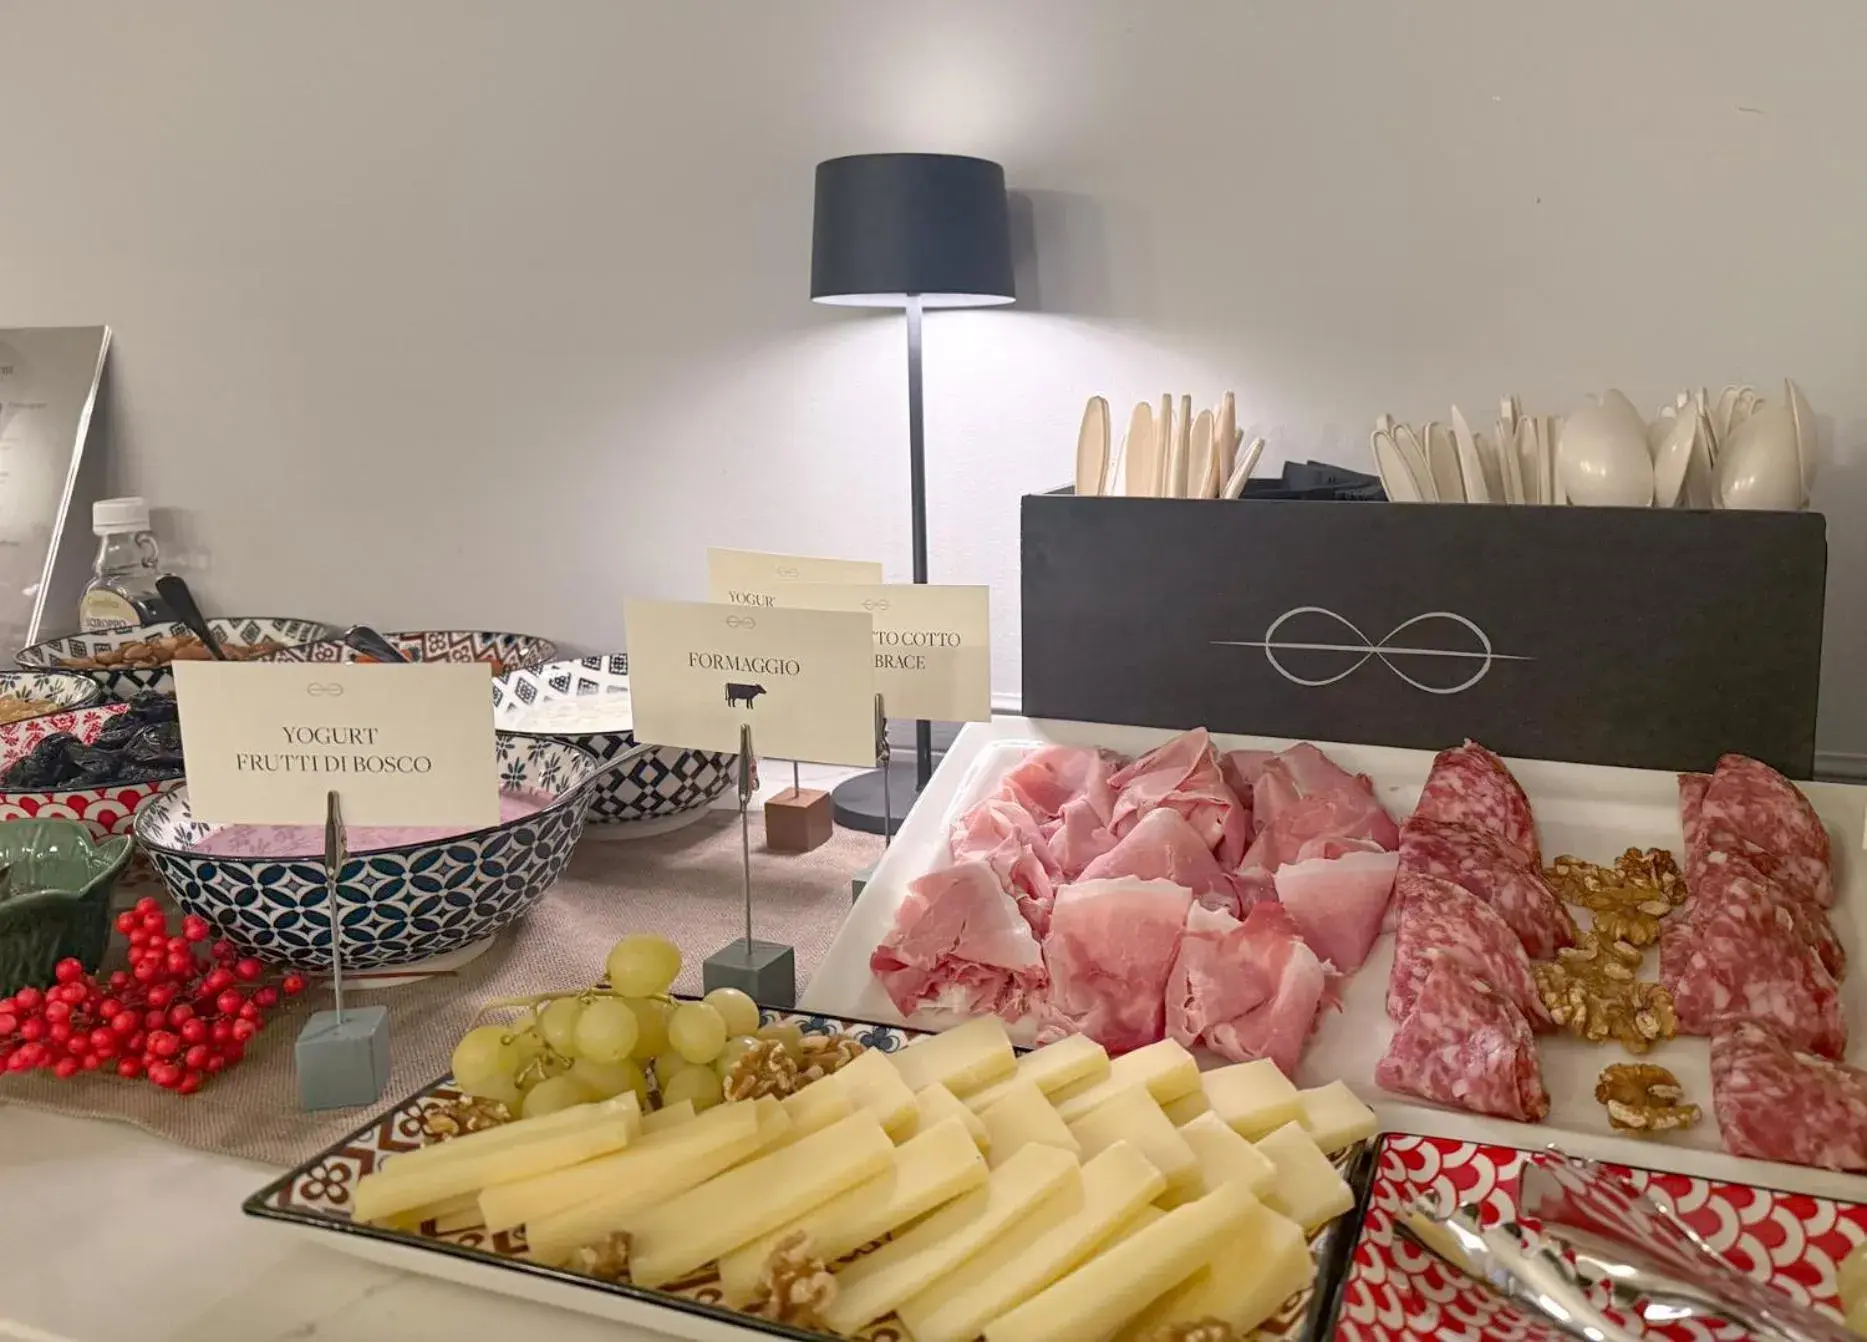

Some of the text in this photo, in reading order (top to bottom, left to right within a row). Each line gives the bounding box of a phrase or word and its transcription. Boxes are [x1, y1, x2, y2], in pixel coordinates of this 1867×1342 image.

[728, 590, 775, 607] YOGUR
[901, 631, 961, 647] COTTO
[688, 652, 800, 676] FORMAGGIO
[875, 654, 926, 669] BRACE
[283, 726, 378, 745] YOGURT
[236, 753, 432, 773] FRUTTI DI BOSCO
